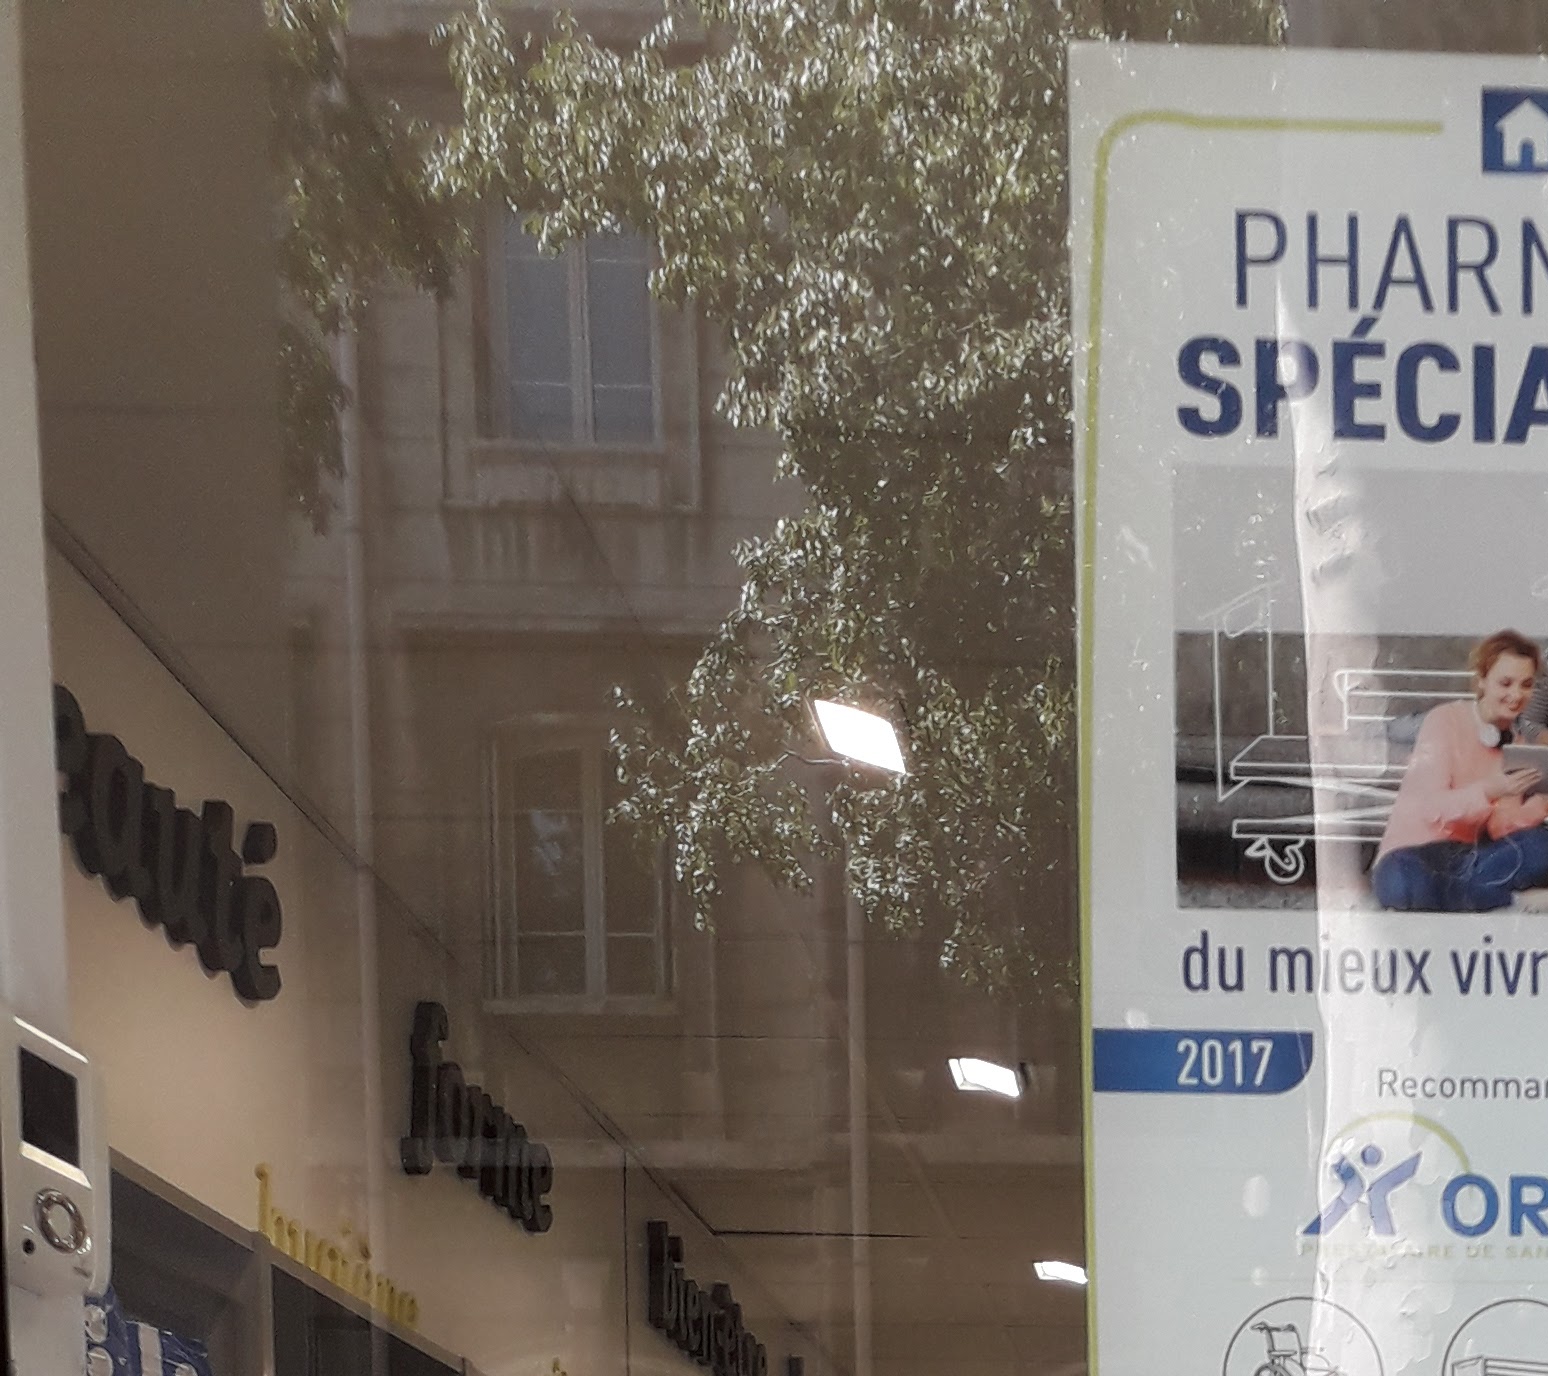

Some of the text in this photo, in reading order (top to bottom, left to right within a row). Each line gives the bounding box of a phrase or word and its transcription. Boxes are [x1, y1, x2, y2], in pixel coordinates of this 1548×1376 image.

[1182, 931, 1245, 995] du
[1268, 935, 1428, 997] mieux
[1176, 1037, 1274, 1088] 2017
